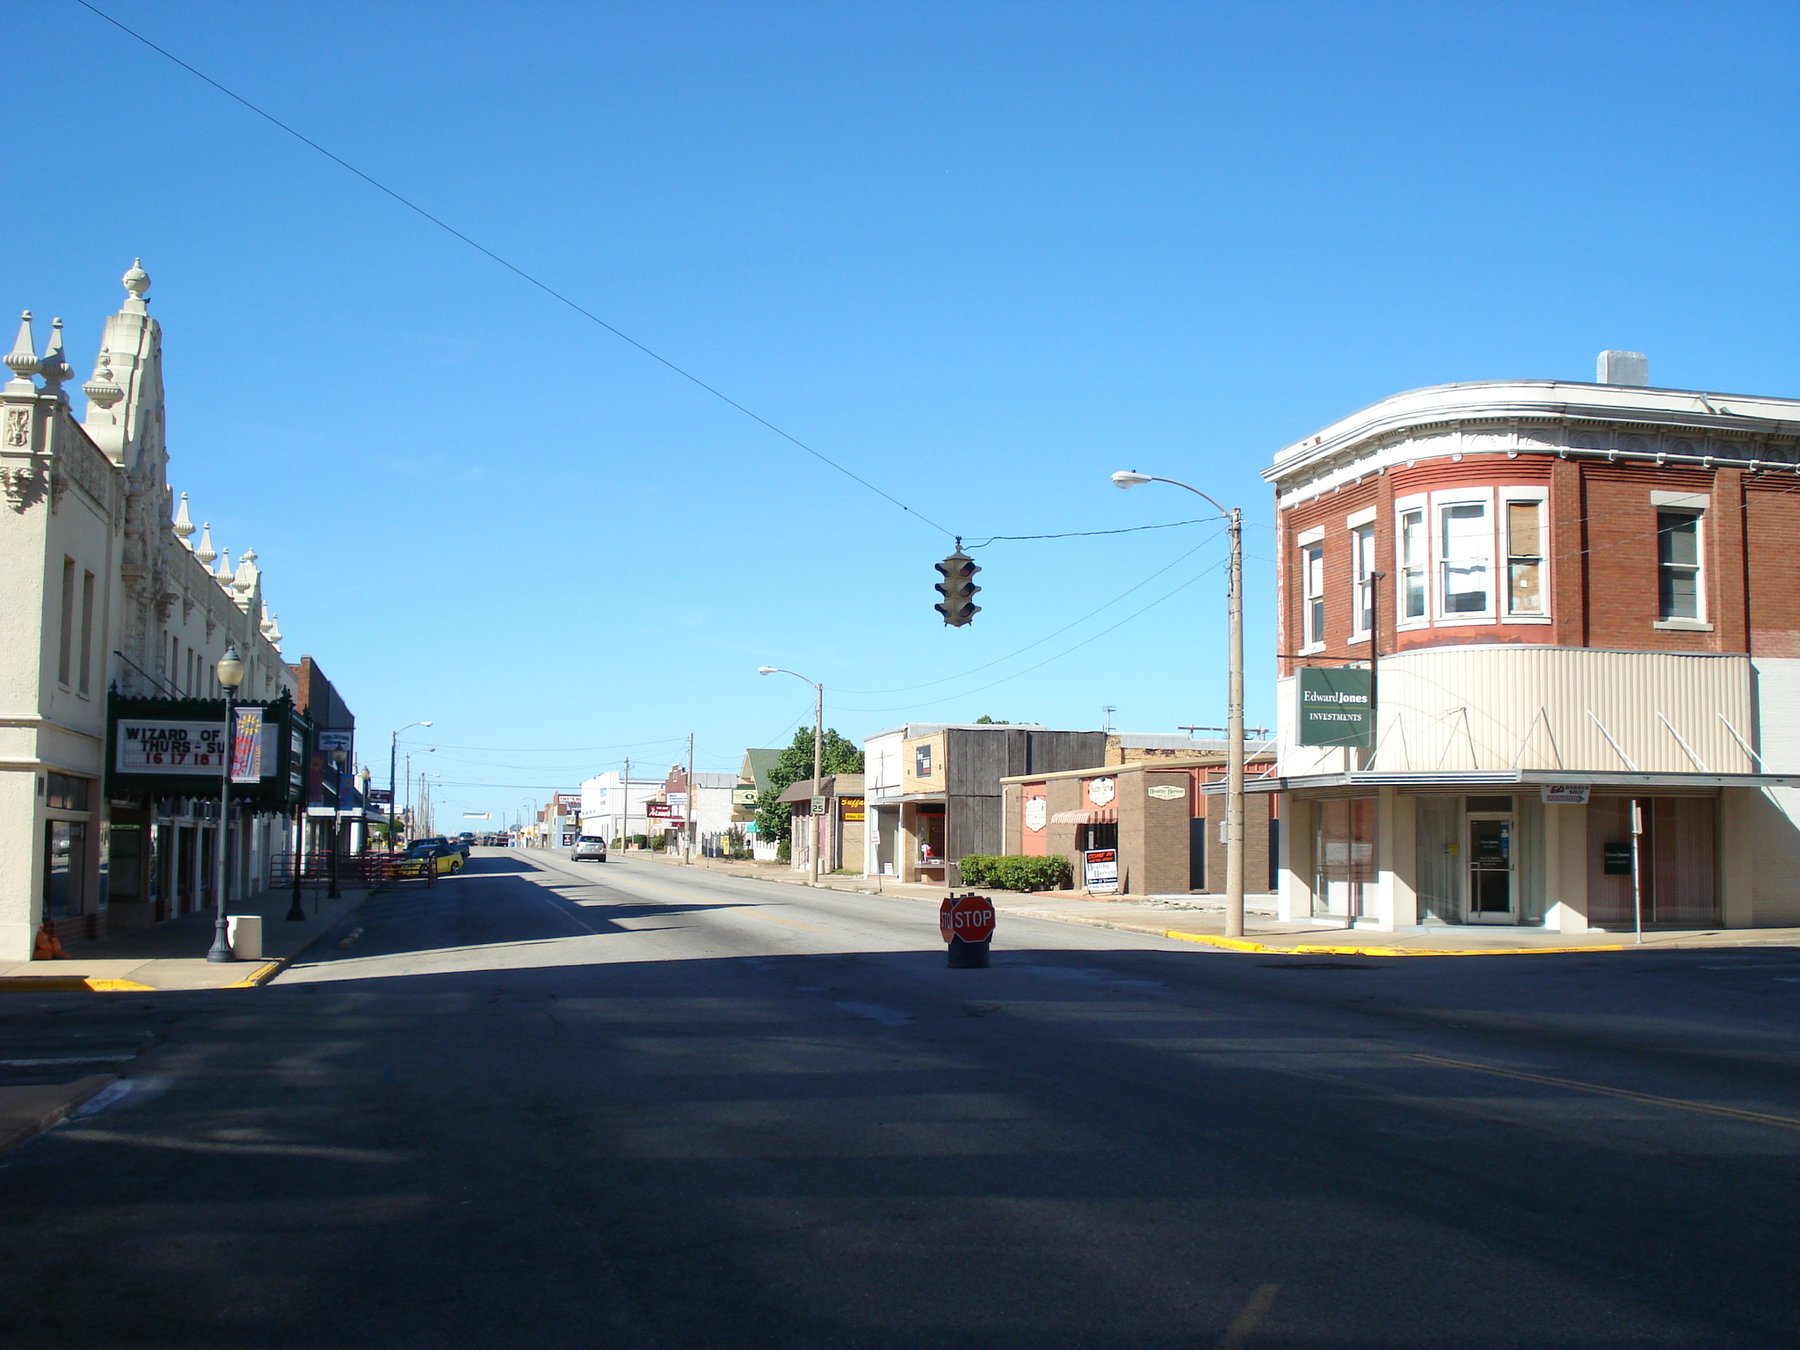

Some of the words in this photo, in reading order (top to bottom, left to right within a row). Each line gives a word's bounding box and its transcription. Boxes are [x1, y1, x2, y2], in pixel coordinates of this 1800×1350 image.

[1310, 713, 1362, 721] INVESTMENTS
[126, 728, 188, 741] WIZARD
[200, 730, 221, 741] OF
[141, 740, 191, 753] THURS
[207, 742, 225, 754] SU
[146, 753, 163, 764] 16
[172, 753, 186, 765] 17
[194, 753, 209, 766] 18
[813, 804, 824, 812] 25
[941, 911, 951, 928] STO
[955, 910, 993, 928] STOP
